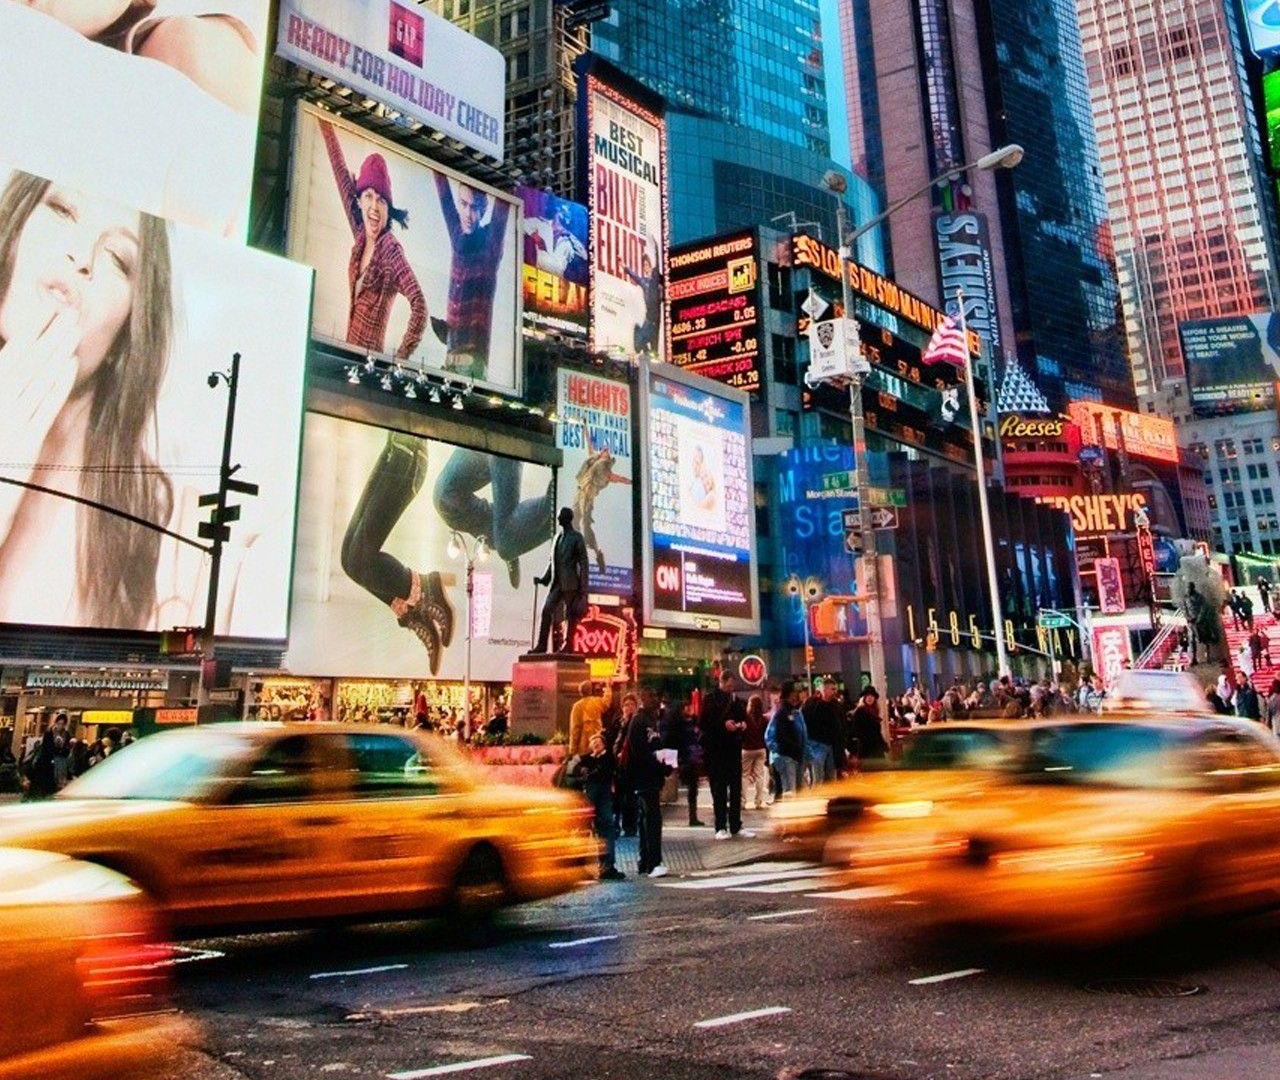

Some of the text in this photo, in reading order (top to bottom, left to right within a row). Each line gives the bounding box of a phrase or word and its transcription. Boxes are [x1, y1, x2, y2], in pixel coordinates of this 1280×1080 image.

[396, 20, 417, 48] GAP
[287, 13, 498, 145] READY FOR HOLIDAY CHEER
[609, 120, 643, 155] BEST
[594, 133, 658, 186] MUSICAL
[596, 164, 639, 231] BILLY
[596, 220, 648, 286] ELLIOT
[670, 237, 753, 269] THOMSON REUTERS
[937, 214, 991, 340] SHEY'S
[568, 374, 628, 416] HEIGHTS
[563, 421, 585, 449] BEST
[1000, 415, 1063, 437] Reese's
[1036, 493, 1147, 531] SHEY'S
[656, 565, 679, 591] CNN
[743, 662, 763, 678] W
